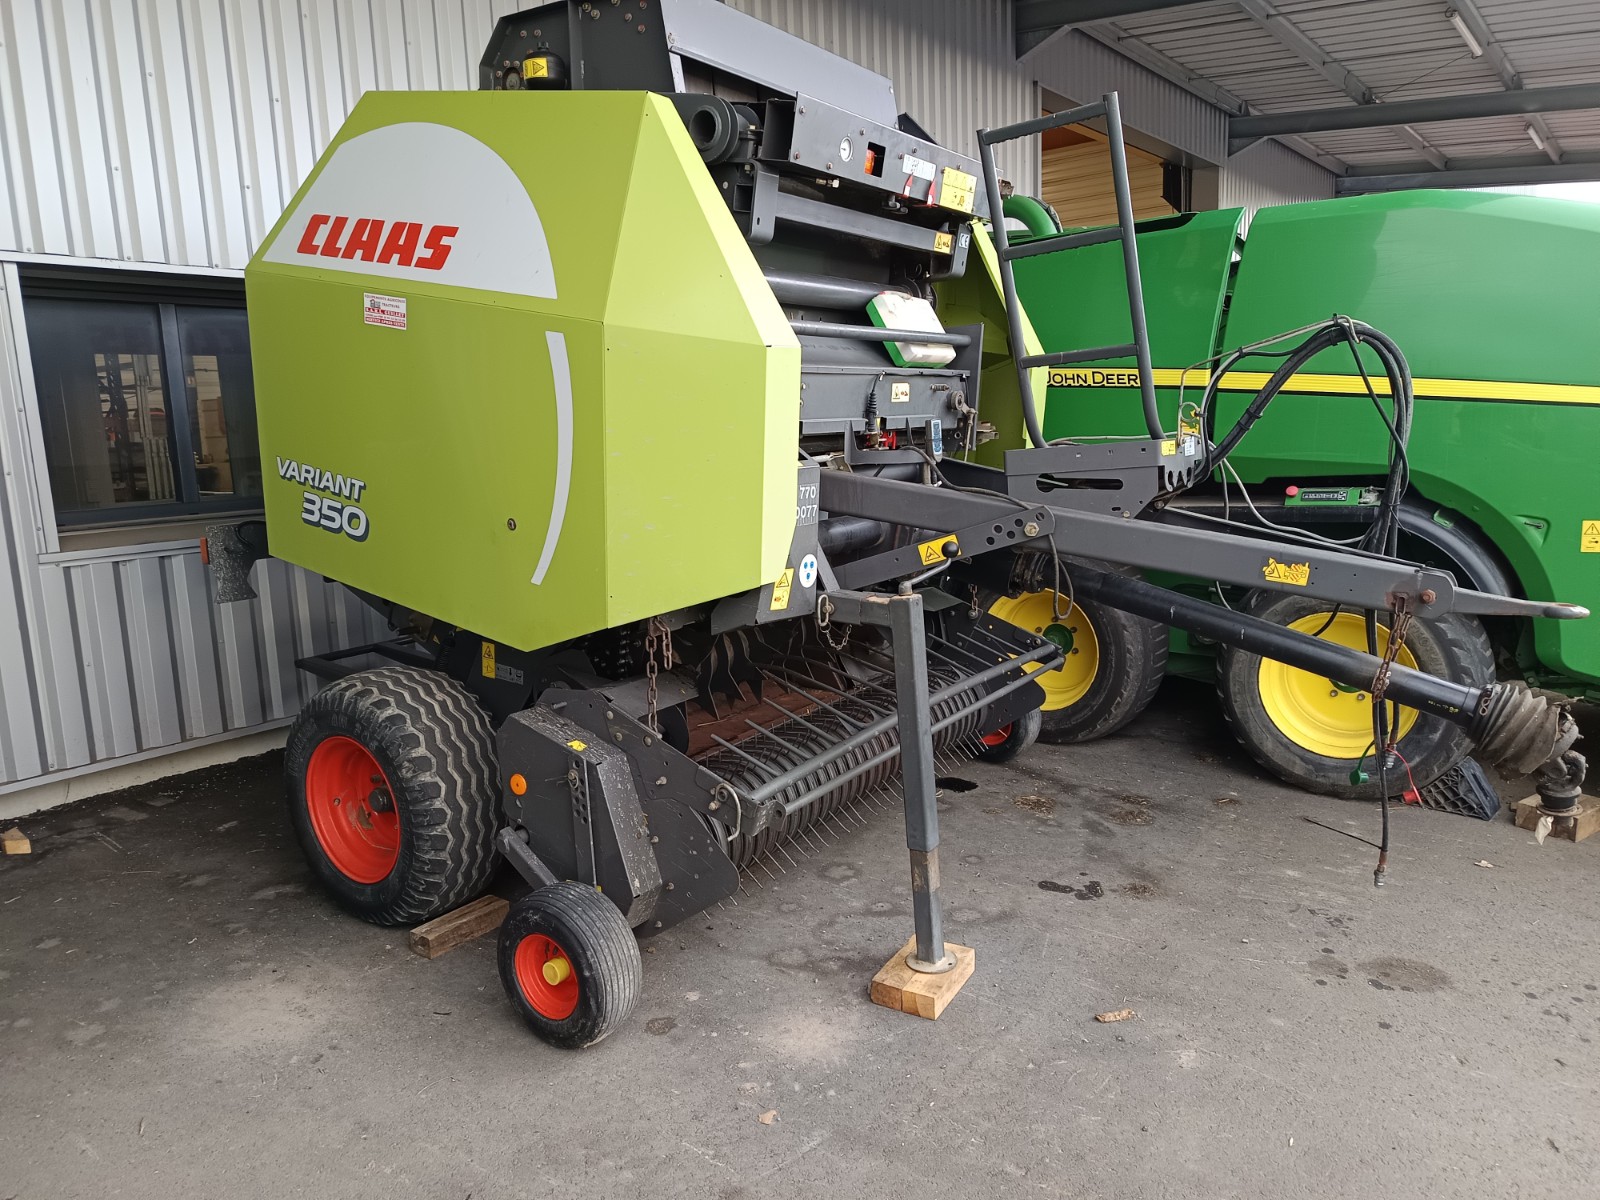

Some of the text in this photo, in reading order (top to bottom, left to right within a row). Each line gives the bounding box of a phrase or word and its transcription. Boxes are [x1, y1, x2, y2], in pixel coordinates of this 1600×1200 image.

[297, 214, 459, 270] CLAAS
[1047, 370, 1139, 385] JOHN DEER
[276, 456, 366, 502] VARIANT
[800, 486, 816, 499] 770
[301, 491, 370, 542] 350
